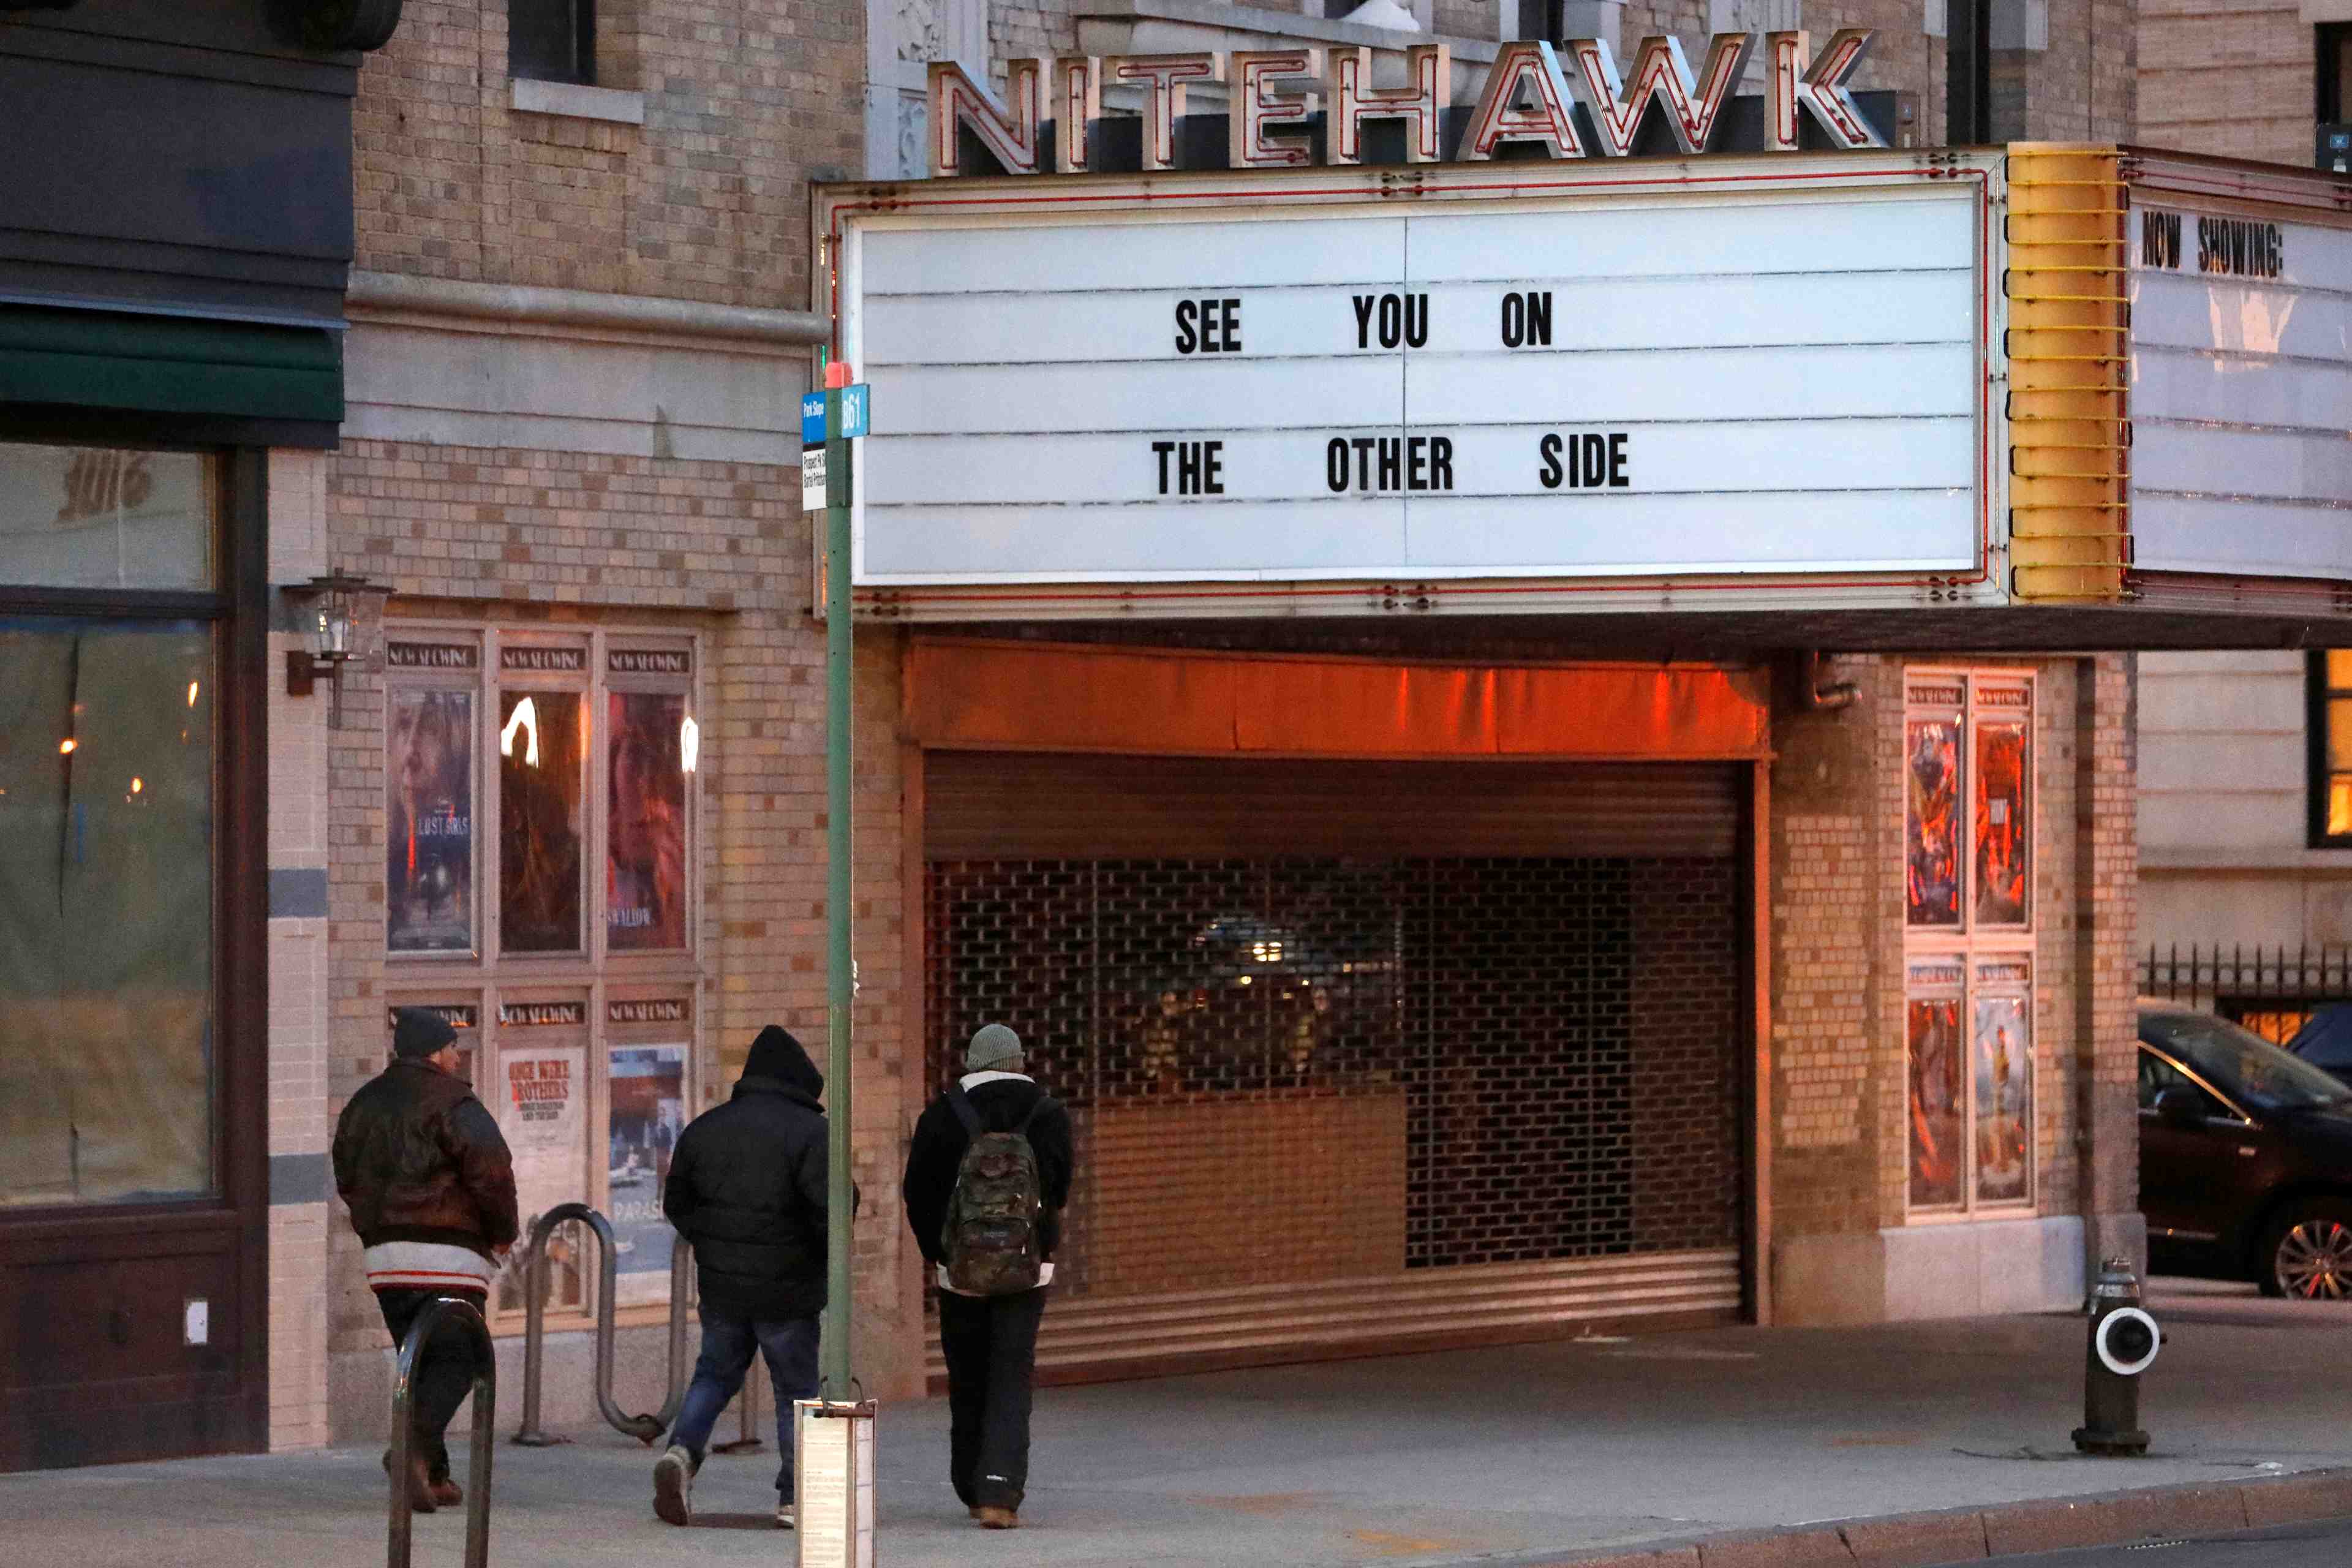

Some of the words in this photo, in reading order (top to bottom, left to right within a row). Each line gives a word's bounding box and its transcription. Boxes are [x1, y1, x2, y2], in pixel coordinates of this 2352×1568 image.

[927, 29, 1887, 176] NITEHAWK
[2143, 211, 2181, 268] NOW
[1176, 299, 1242, 354] SEE
[1353, 293, 1428, 349] YOU
[1502, 292, 1553, 348] ON
[804, 402, 813, 417] Park
[813, 401, 824, 418] Slope
[1152, 441, 1224, 495] THE
[1327, 437, 1453, 492] OTHER
[1539, 433, 1629, 489] SIDE
